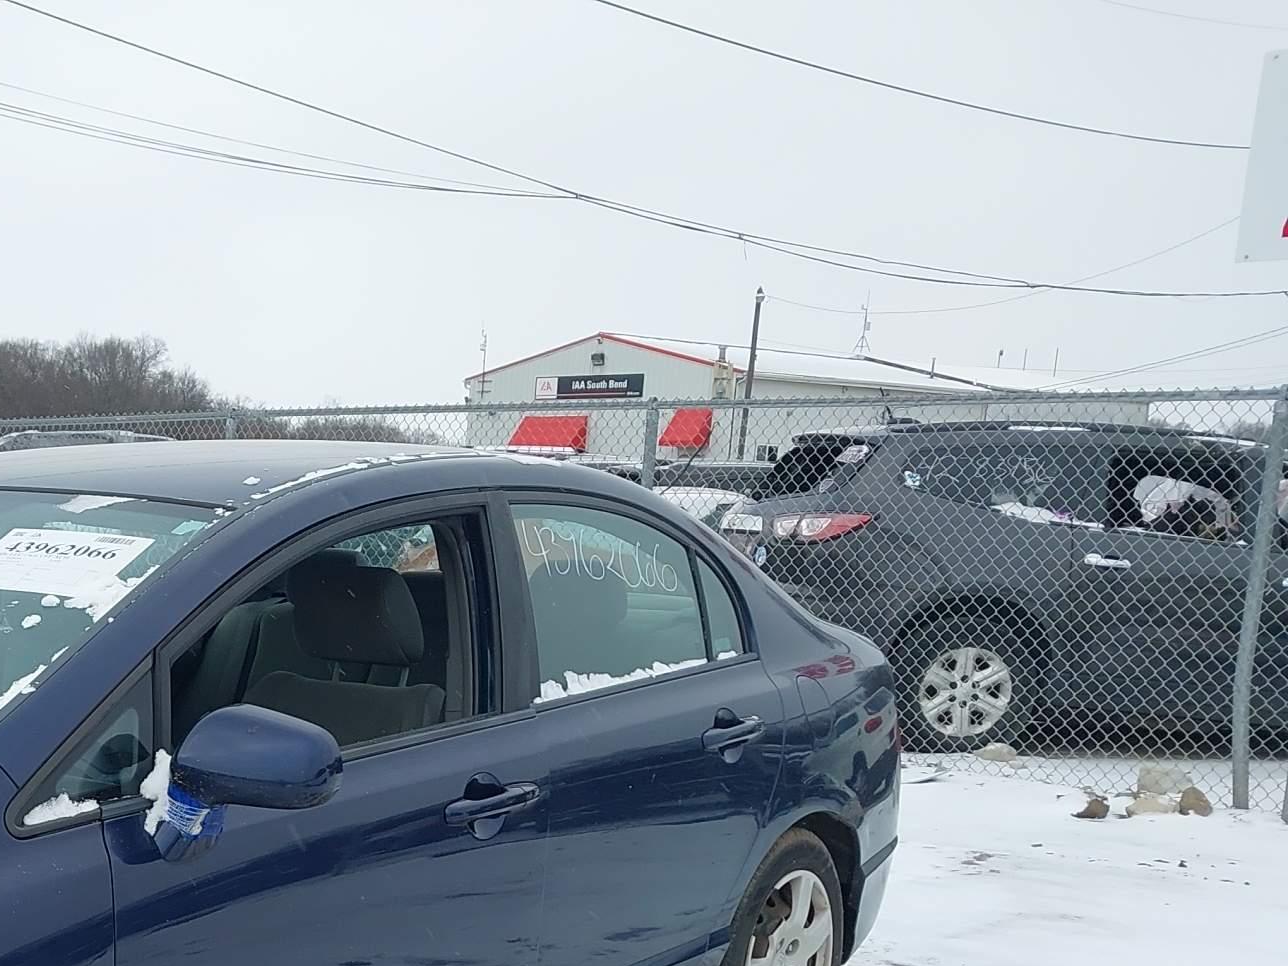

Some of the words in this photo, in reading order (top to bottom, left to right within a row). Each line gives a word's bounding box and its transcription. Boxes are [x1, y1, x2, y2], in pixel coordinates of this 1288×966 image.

[572, 380, 585, 390] IAA
[586, 379, 608, 389] South
[608, 379, 628, 389] Bend
[5, 541, 122, 561] 43962066
[520, 519, 678, 592] 43962066
